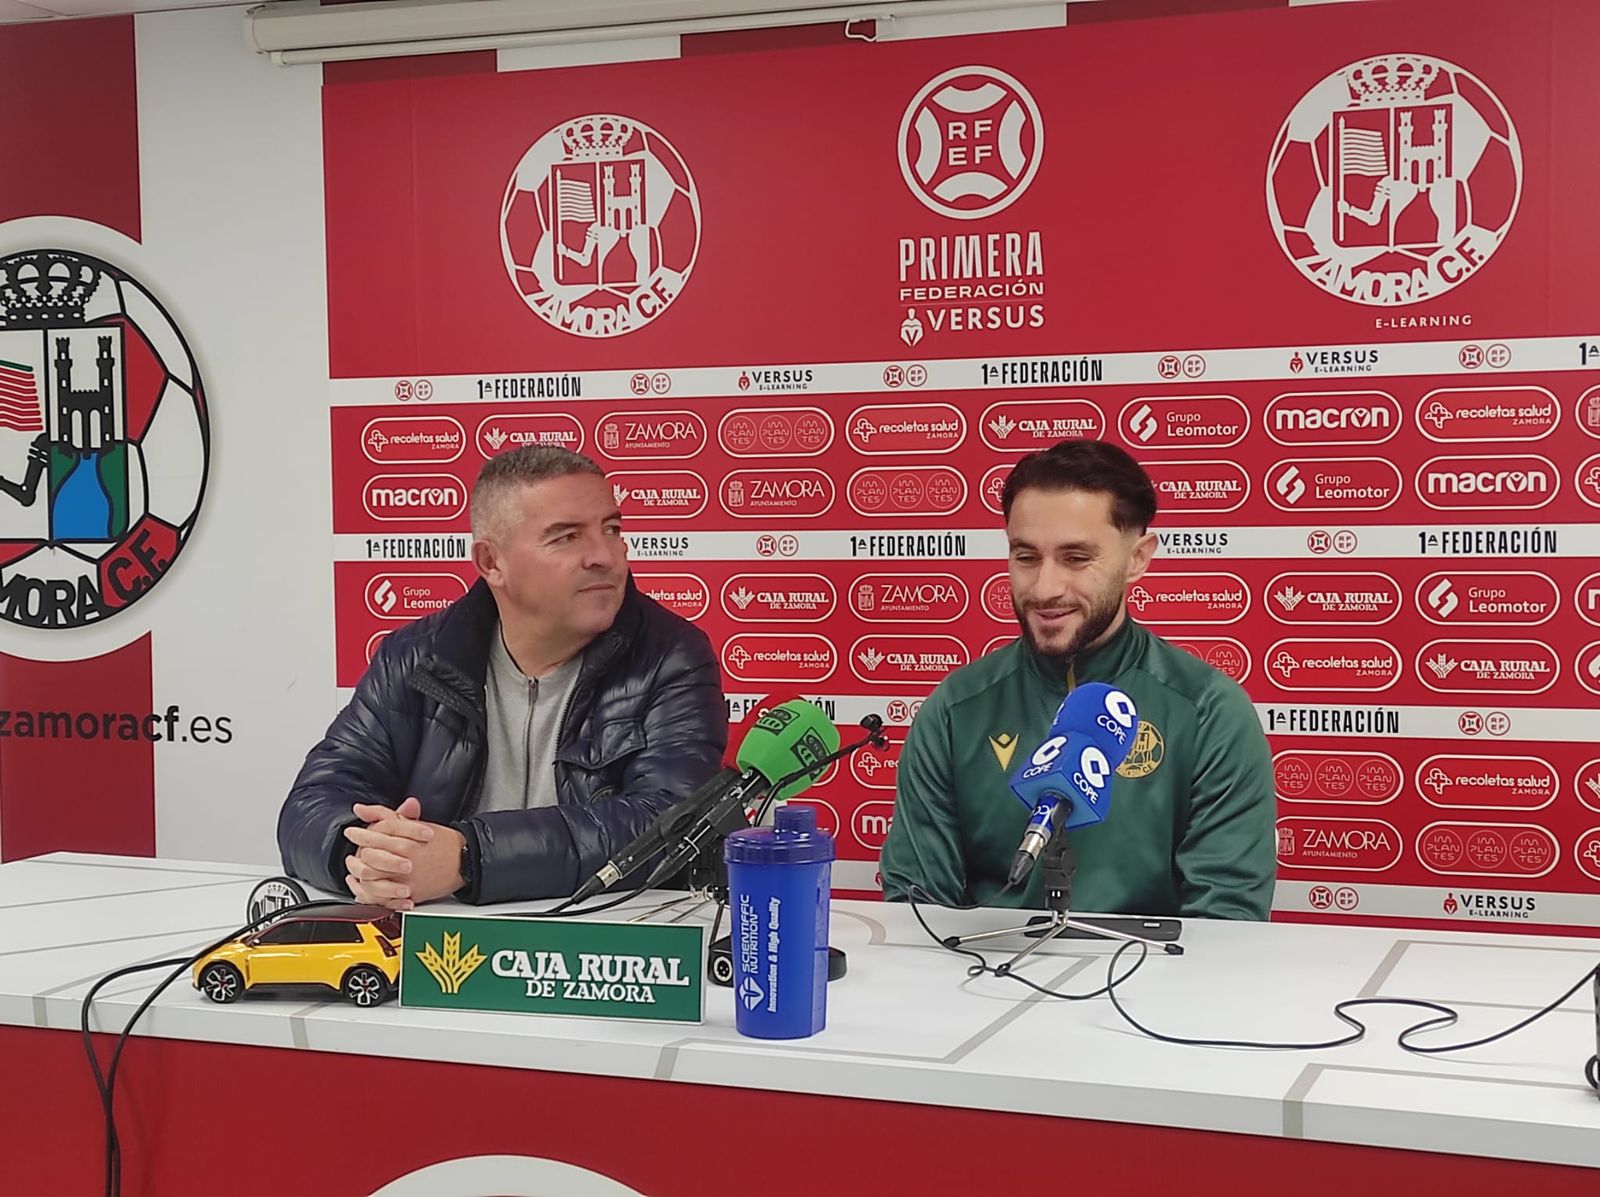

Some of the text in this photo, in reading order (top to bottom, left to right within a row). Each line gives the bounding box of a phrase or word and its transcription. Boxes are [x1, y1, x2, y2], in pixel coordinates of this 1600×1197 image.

[899, 231, 1044, 283] PRIMERA
[1294, 255, 1430, 304] ZAMORA
[899, 279, 1044, 302] FEDERACIÓN
[524, 291, 632, 336] ZAMORA
[927, 304, 1045, 332] VERSUS
[1375, 314, 1473, 329] E-LEARNING
[1306, 350, 1379, 365] VERSUS
[1001, 357, 1103, 384] FEDERACIÓN
[1314, 365, 1372, 373] E-LEARNING
[751, 369, 814, 384] VERSUS
[494, 374, 582, 399] FEDERACIÓN
[759, 383, 808, 391] E-LEARNING
[1166, 412, 1201, 425] Grupo
[1275, 407, 1390, 430] macron
[1456, 404, 1552, 419] recoletas salud
[624, 422, 698, 441] ZAMORA
[879, 419, 959, 433] recoletas salud
[1018, 419, 1097, 431] CAJA RURAL
[1167, 423, 1239, 437] Leomotor
[390, 432, 460, 444] recoletas salud
[509, 431, 578, 443] CAJA RURAL
[926, 432, 959, 440] ZAMORA
[1047, 430, 1084, 438] ZAMORA
[1159, 480, 1242, 492] CAJA RURAL
[1314, 474, 1351, 487] Grupo
[1427, 470, 1547, 494] macron
[631, 488, 701, 500] CAJA RURAL
[750, 480, 825, 498] ZAMORA
[1189, 491, 1228, 499] ZAMORA
[1315, 485, 1390, 499] Leomotor
[371, 487, 458, 507] macron
[382, 535, 466, 558] FEDERACIÓN
[630, 537, 690, 550] VERSUS
[869, 532, 966, 557] FEDERACIÓN
[1159, 533, 1229, 547] VERSUS
[1441, 527, 1558, 554] FEDERACIÓN
[0, 529, 169, 626] MORA C.F.
[403, 586, 431, 598] Grupo
[676, 589, 703, 600] salud
[756, 592, 829, 603] CAJA RURAL
[880, 584, 959, 603] ZAMORA
[1156, 589, 1243, 602] recoletas salud
[1307, 592, 1393, 604] CAJA RURAL
[1468, 587, 1506, 600] Grupo
[769, 602, 817, 610] DE ZAMORA
[1207, 602, 1243, 610] ZAMORA
[1338, 603, 1379, 611] ZAMORA
[1469, 599, 1548, 613] Leomotor
[753, 650, 830, 662] recoletas salud
[886, 653, 962, 665] CAJA RURAL
[1302, 656, 1393, 669] recoletas salud
[900, 664, 950, 672] DE ZAMORA
[1356, 669, 1393, 677] ZAMORA
[1460, 660, 1550, 673] CAJA RURAL
[1493, 672, 1535, 680] ZAMORA
[1289, 707, 1400, 734] FEDERACIÓN
[1096, 715, 1127, 745] COPE
[1022, 762, 1054, 780] COPE
[1073, 771, 1099, 804] COPE
[1455, 774, 1550, 787] recoletas salud
[1511, 788, 1551, 796] ZAMORA
[1302, 829, 1391, 851] ZAMORA
[1302, 850, 1358, 859] AYUNTAMIENTO
[1460, 894, 1536, 911] VERSUS
[1469, 910, 1529, 918] E-LEARNING
[491, 949, 690, 987] CAJA RURAL
[525, 979, 657, 1005] DE ZAMORA
